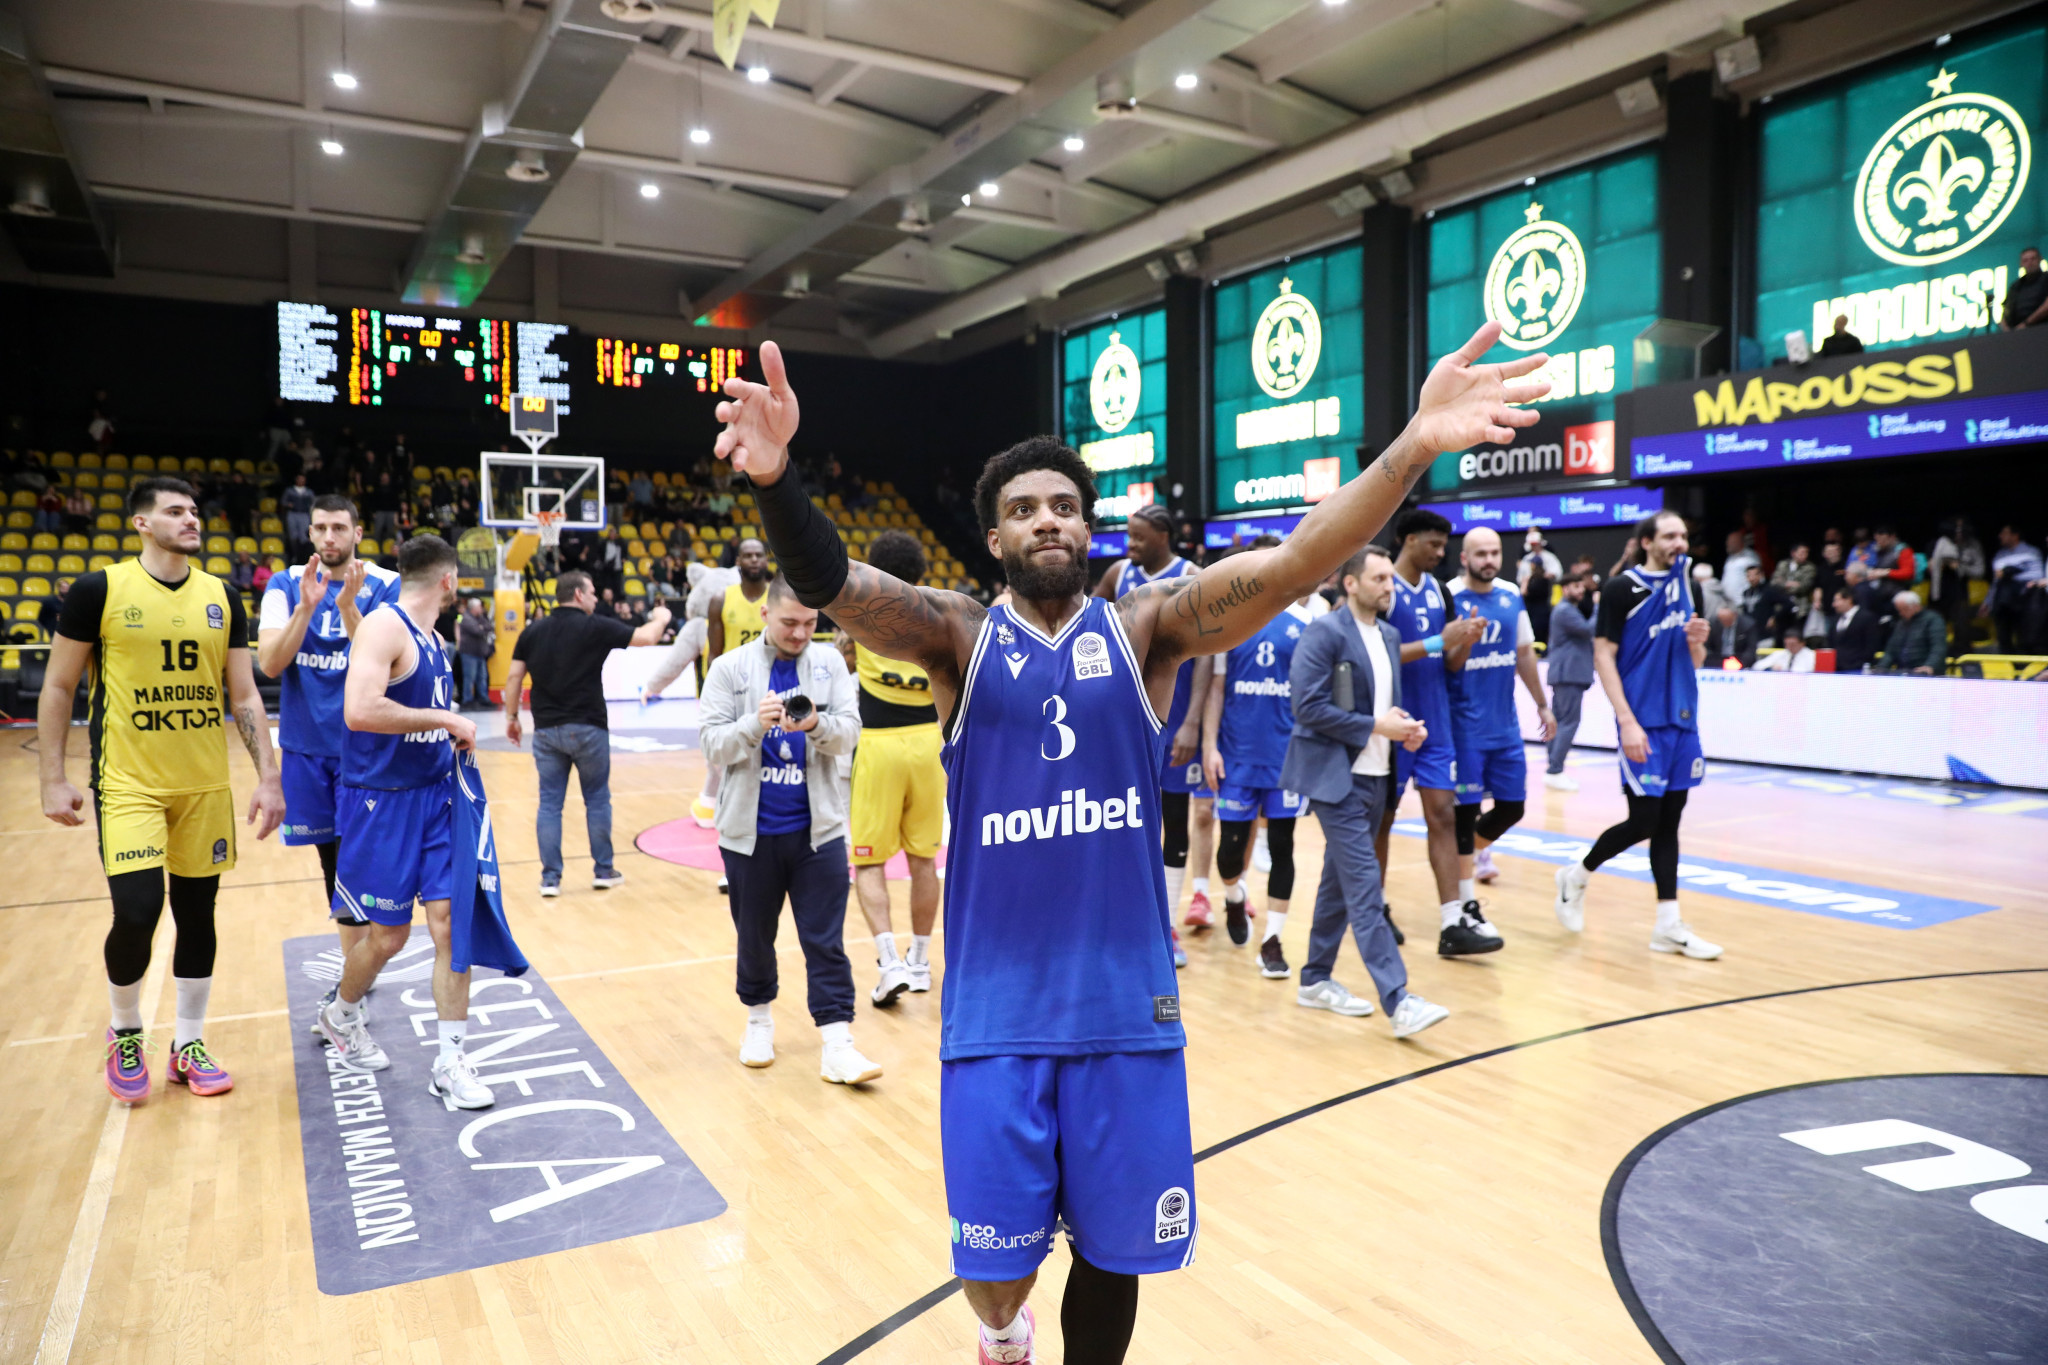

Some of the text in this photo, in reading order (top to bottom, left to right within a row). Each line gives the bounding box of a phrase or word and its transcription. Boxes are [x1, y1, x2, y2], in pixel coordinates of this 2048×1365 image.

[1693, 348, 1974, 428] MAROUSSI
[1175, 576, 1265, 637] Loretta
[317, 610, 348, 637] 14
[1415, 607, 1430, 632] 5
[161, 639, 199, 671] 16
[296, 651, 347, 671] novib
[1076, 657, 1108, 667] Stoiximan
[1256, 641, 1275, 667] 8
[1465, 649, 1518, 671] novibet
[1078, 663, 1109, 677] GBL
[1234, 677, 1292, 698] novibet
[1041, 694, 1076, 761] 3
[760, 763, 807, 786] ovib
[981, 786, 1143, 846] novibet
[339, 1125, 420, 1250] ΜΑΛΛΙΩΝ
[962, 1221, 996, 1237] eco
[1158, 1217, 1188, 1229] Stoiximan
[1159, 1225, 1186, 1240] GBL
[963, 1226, 1046, 1250] resources
